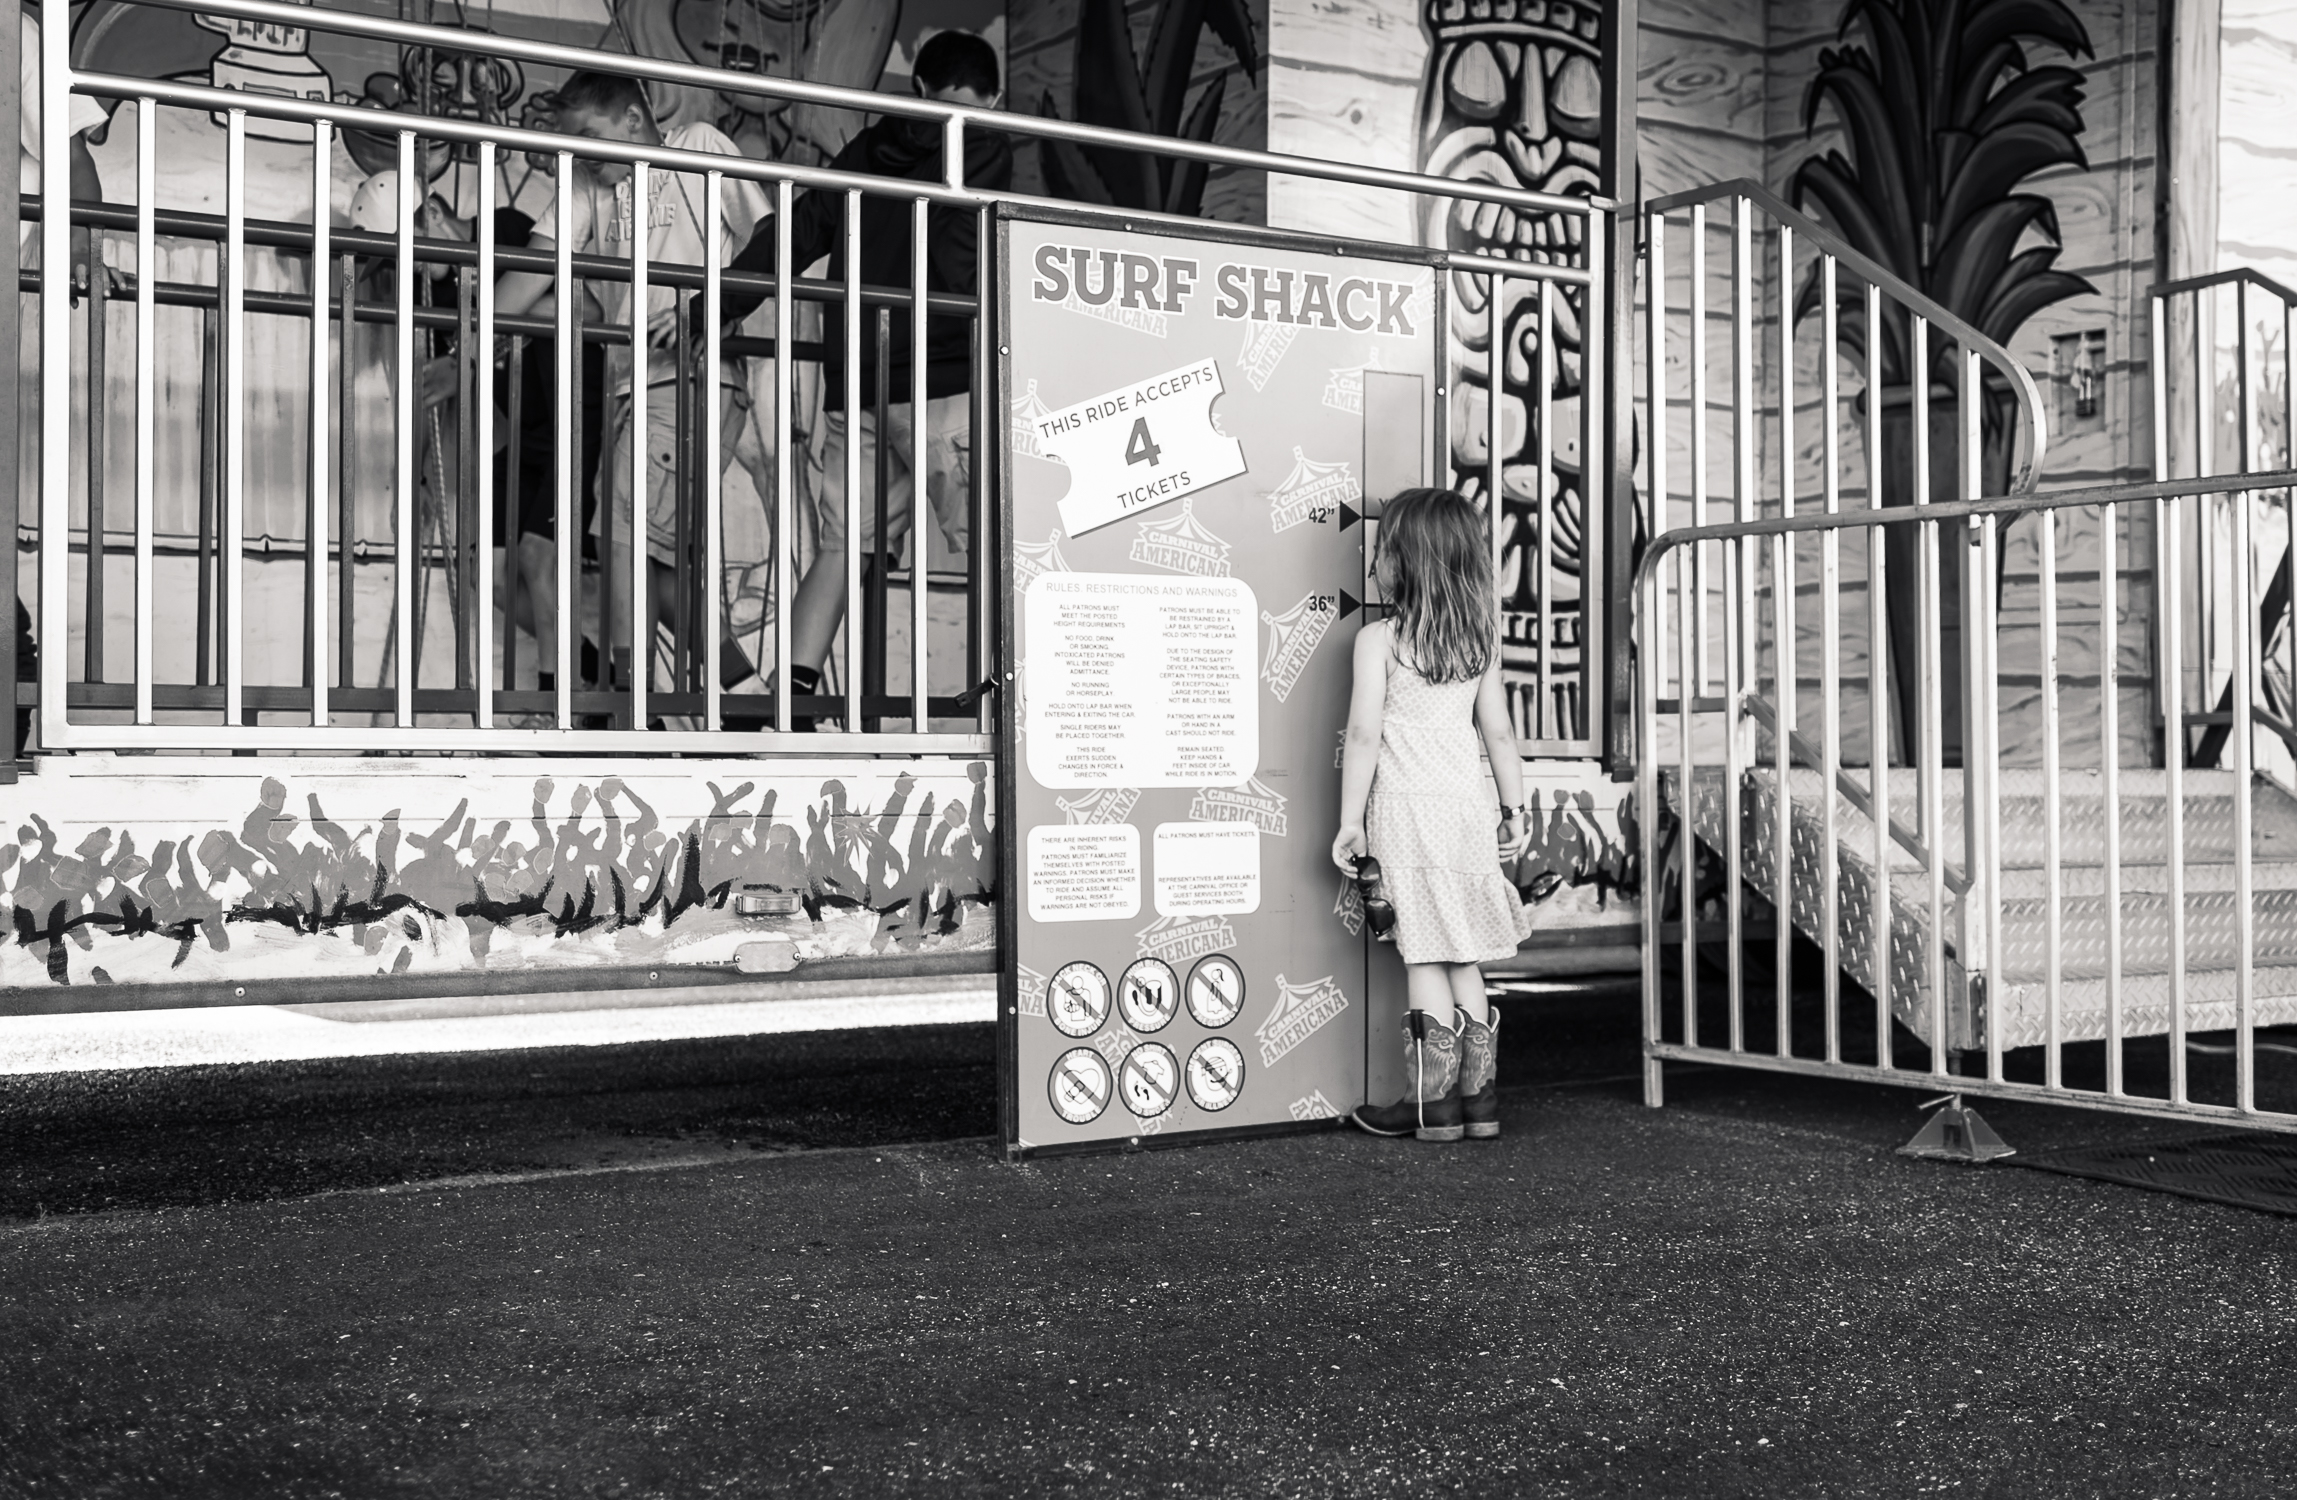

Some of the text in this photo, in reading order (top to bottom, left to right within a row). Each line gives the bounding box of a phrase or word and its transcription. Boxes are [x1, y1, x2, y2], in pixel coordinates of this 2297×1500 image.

[1033, 243, 1198, 314] SURF
[1215, 264, 1416, 336] SHACK
[1039, 413, 1081, 439] THIS
[1085, 396, 1130, 423] RIDE
[1135, 366, 1213, 407] ACCEPTS
[1124, 416, 1162, 467] 4
[1117, 471, 1191, 508] TICKETS
[1273, 481, 1360, 531] AMERICANA
[1280, 472, 1342, 506] CARNIVAL
[1132, 541, 1230, 578] AMERICANA
[1148, 531, 1219, 559] CARNIVAL
[1086, 583, 1159, 595] RESTRICTIONS
[1162, 586, 1182, 596] AND
[1186, 587, 1237, 597] WARNINGS
[1208, 789, 1275, 812] CARNIVAL
[1149, 918, 1218, 946] CARNIVAL
[1264, 993, 1346, 1064] AMERICANA
[1268, 990, 1328, 1038] CARNIVAL
[1066, 1049, 1094, 1060] HEART
